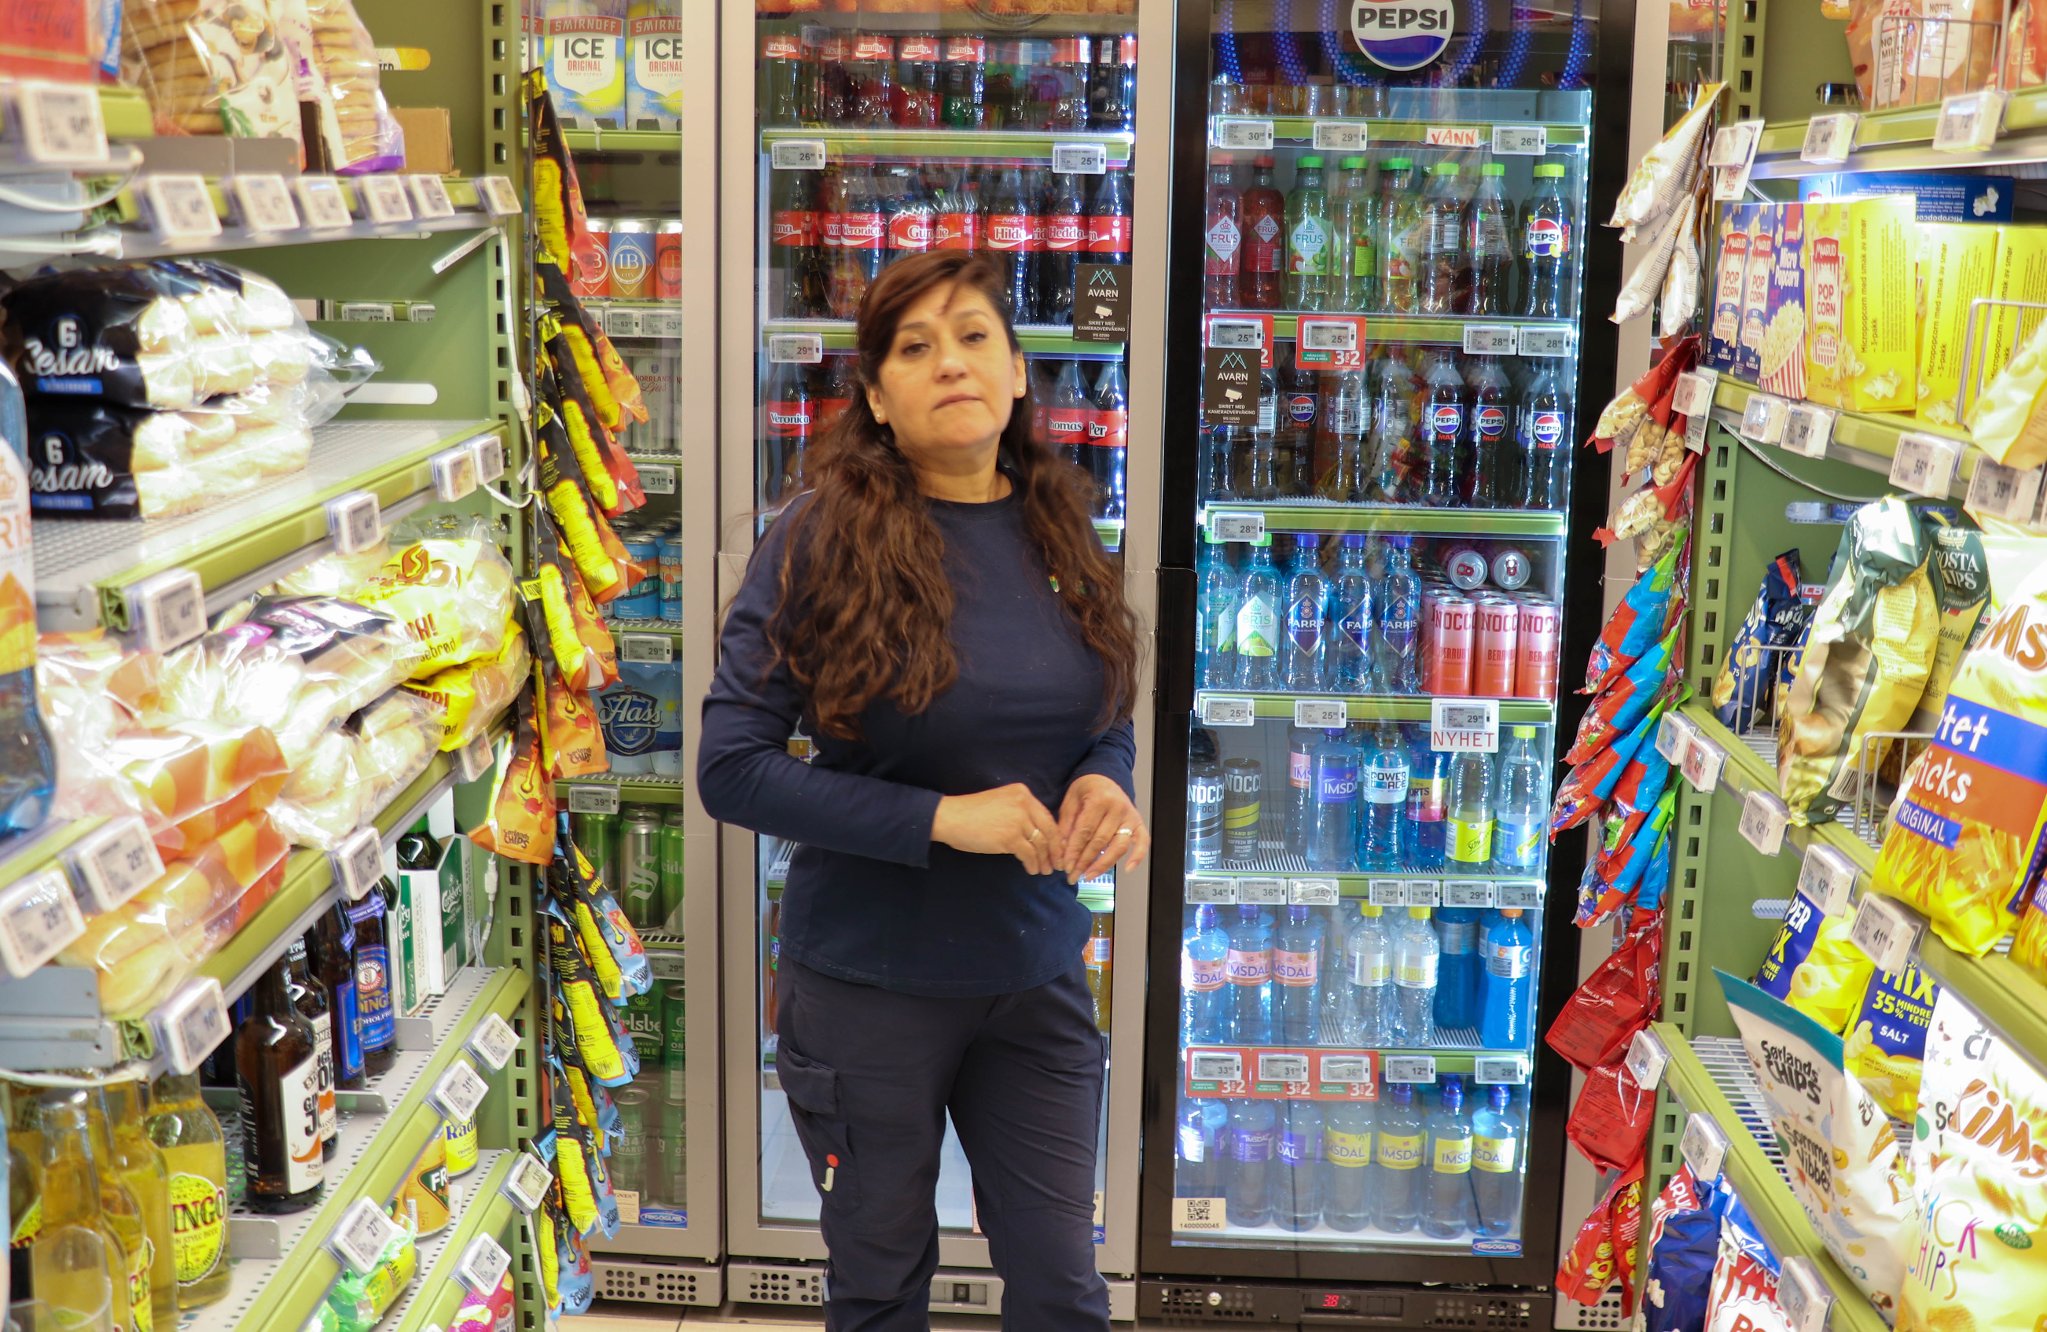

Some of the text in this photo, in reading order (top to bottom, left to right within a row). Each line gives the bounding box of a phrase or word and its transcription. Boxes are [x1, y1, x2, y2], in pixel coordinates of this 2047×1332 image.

[555, 18, 616, 32] SMIRNOFF
[1358, 8, 1448, 31] PEPSI
[564, 37, 605, 59] ICE
[645, 38, 683, 60] ICE
[567, 60, 602, 71] ORIGINAL
[649, 60, 683, 72] ORIGINAL
[1430, 130, 1478, 146] VANN
[1257, 225, 1277, 234] FRUS
[1210, 233, 1238, 244] FRUS
[1295, 234, 1324, 245] FRUS
[1529, 233, 1560, 242] PEPSI
[1815, 243, 1837, 258] MAARUD
[619, 253, 639, 270] LB
[1724, 271, 1740, 285] POP
[1752, 275, 1766, 288] POP
[1087, 289, 1119, 298] AVARN
[1722, 284, 1740, 299] CORN
[1750, 289, 1765, 304] CORN
[1817, 284, 1835, 301] POP
[1816, 300, 1837, 317] CORN
[57, 319, 77, 347] 6
[1334, 350, 1345, 365] 3
[1350, 350, 1361, 366] 2
[1217, 372, 1249, 381] AVARN
[1291, 405, 1314, 413] PEPSI
[769, 411, 811, 425] Veronica
[1435, 417, 1459, 425] PEPSI
[1480, 418, 1504, 426] PEPSI
[1088, 420, 1108, 437] Per
[45, 436, 65, 465] 6
[600, 694, 663, 725] Aass
[1433, 731, 1495, 748] NYHET
[1871, 989, 1896, 1014] 35
[1896, 999, 1933, 1019] MINDRE
[1907, 1013, 1931, 1029] FETT
[1879, 1024, 1910, 1045] SALT
[1760, 1039, 1820, 1083] Sørlands
[1221, 1080, 1231, 1094] 3
[1236, 1080, 1246, 1094] 2
[1286, 1081, 1296, 1095] 3
[1301, 1081, 1311, 1095] 2
[1350, 1082, 1360, 1096] 3
[1364, 1082, 1375, 1096] 2
[1765, 1058, 1822, 1106] CHIPS
